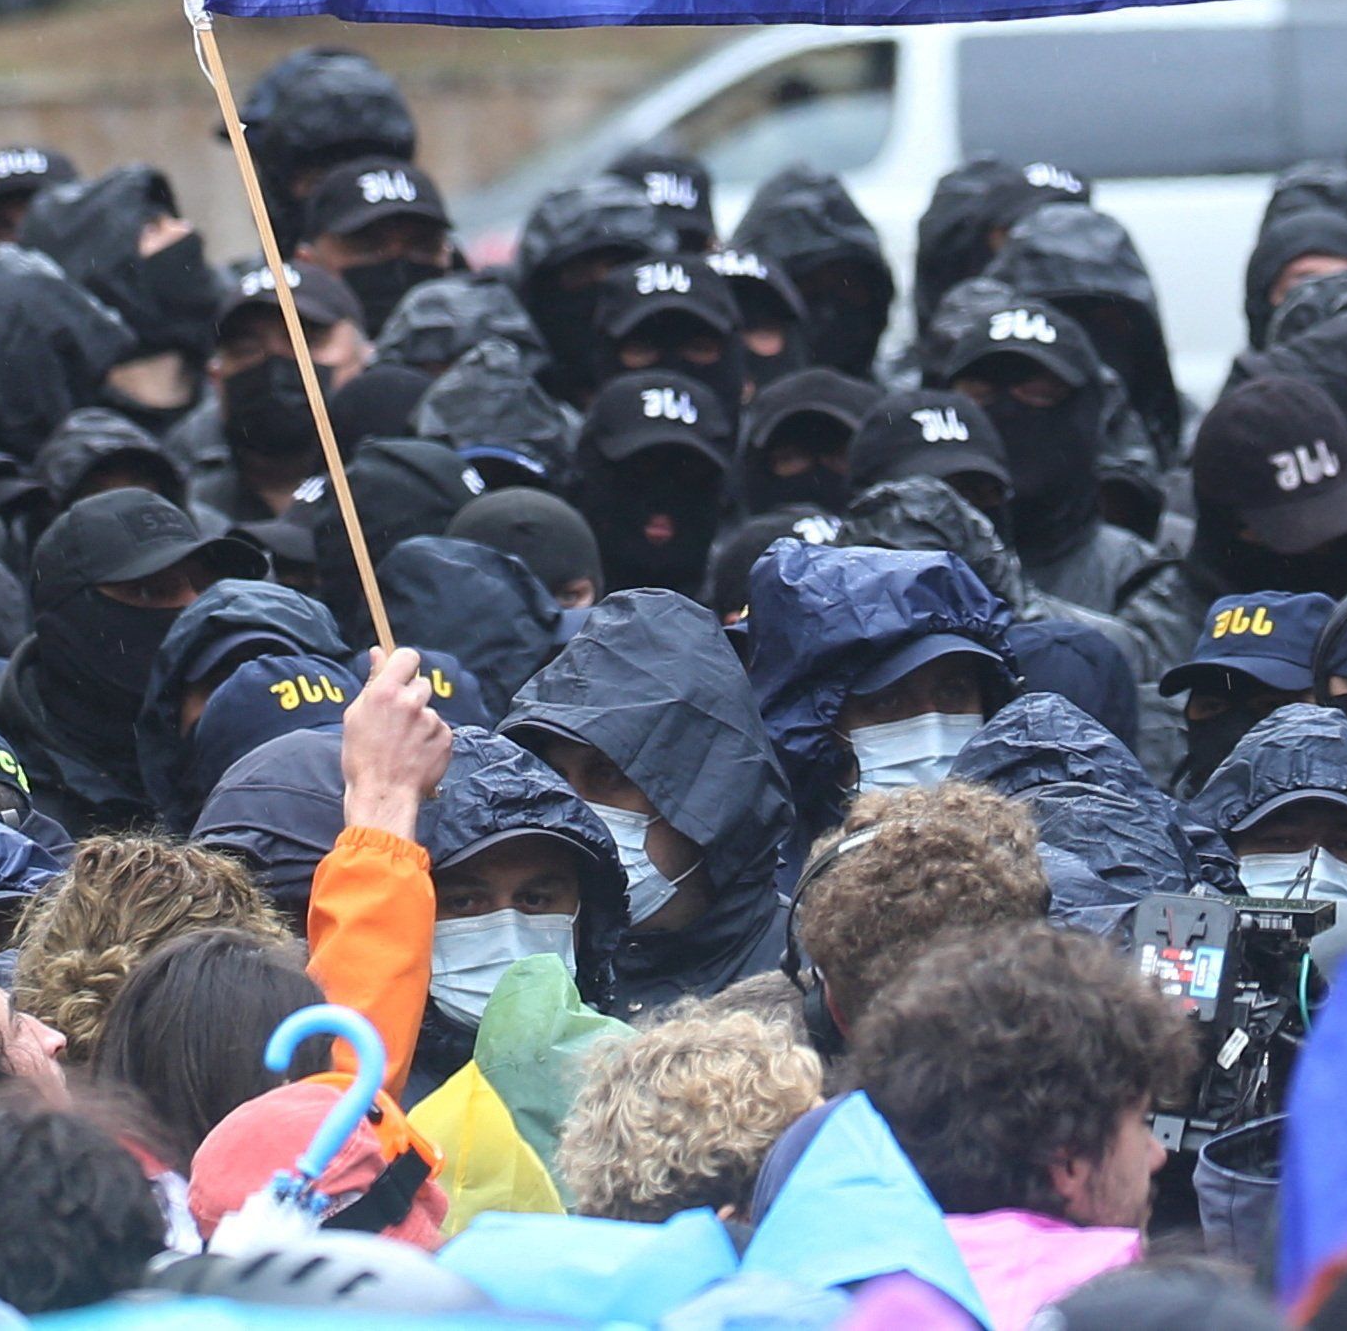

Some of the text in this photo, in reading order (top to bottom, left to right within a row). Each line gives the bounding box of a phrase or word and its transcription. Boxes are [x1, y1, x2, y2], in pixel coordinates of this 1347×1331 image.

[989, 308, 1057, 343] შსს
[1271, 440, 1339, 491] შსს
[269, 675, 346, 711] შსს
